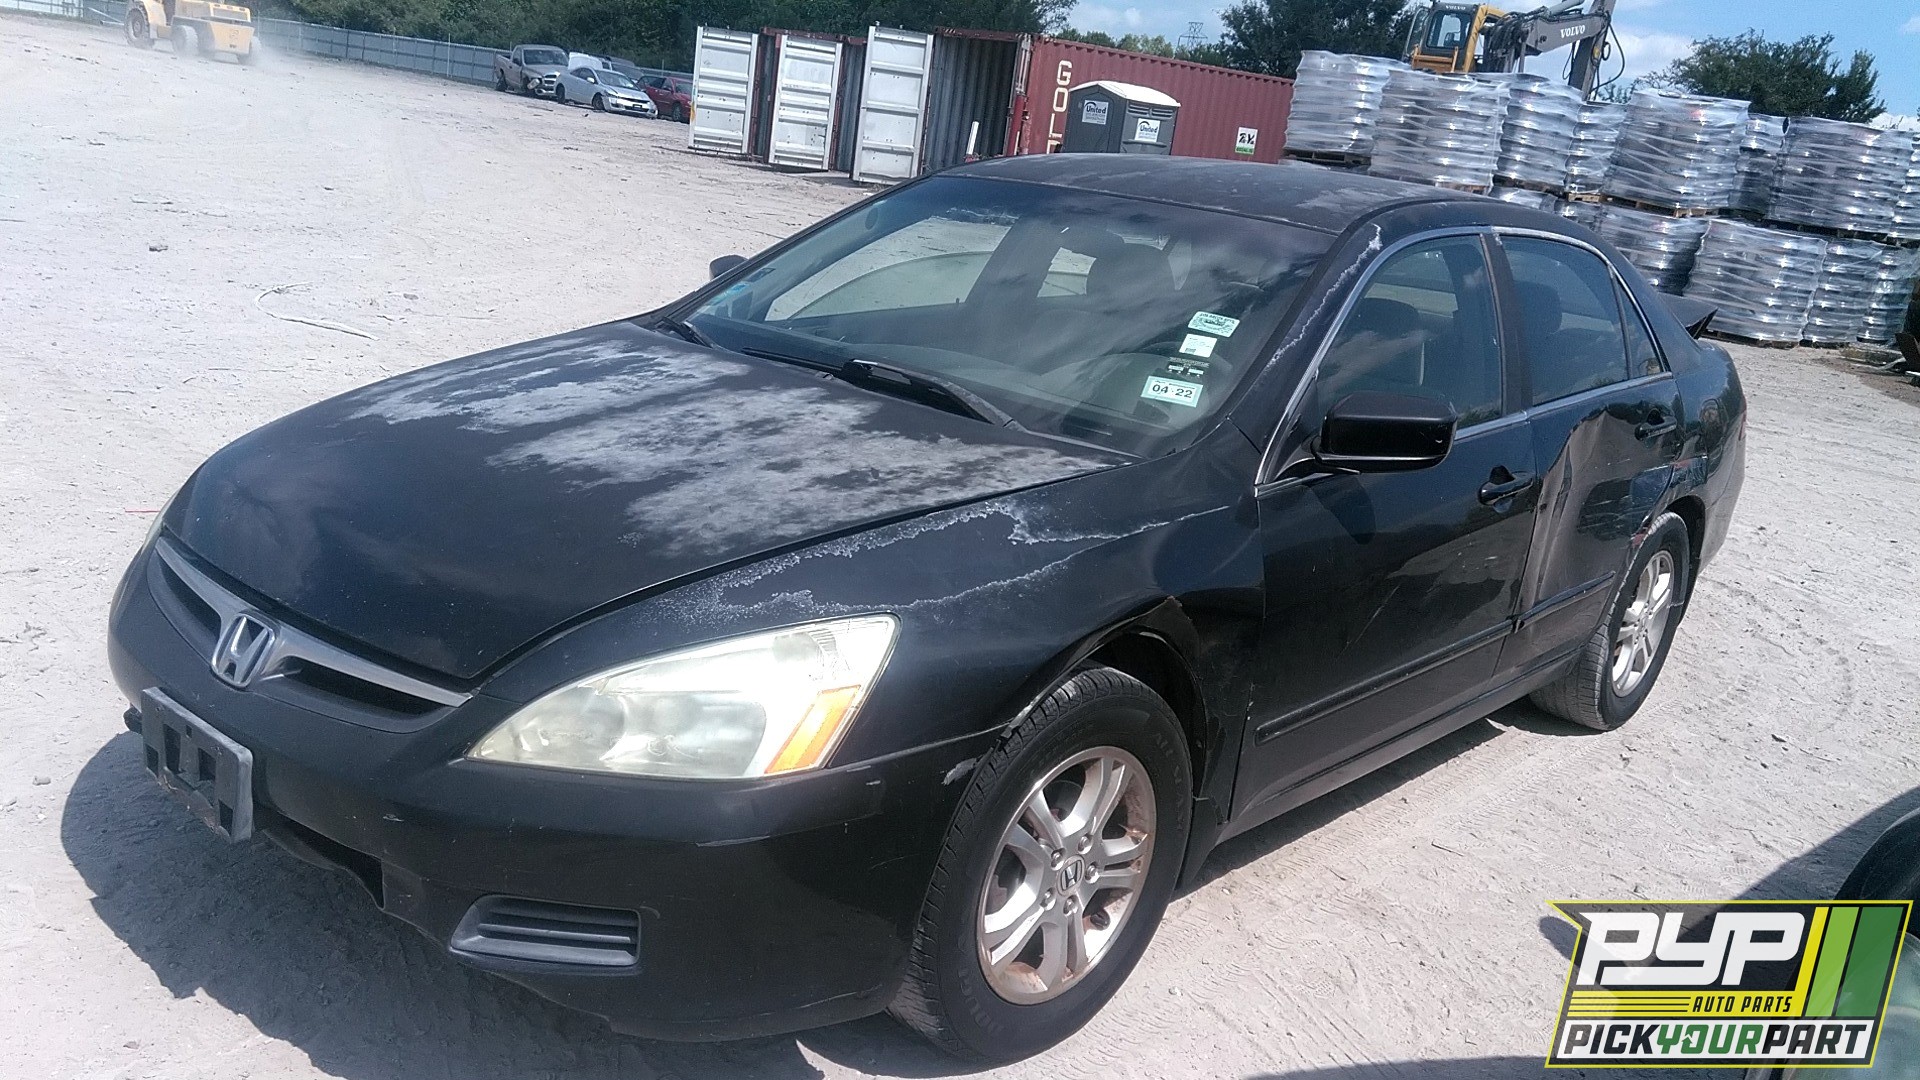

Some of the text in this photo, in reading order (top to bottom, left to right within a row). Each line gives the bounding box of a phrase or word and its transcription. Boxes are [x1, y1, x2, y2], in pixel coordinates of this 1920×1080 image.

[1560, 25, 1585, 38] VOLVO
[1086, 105, 1107, 114] United
[1140, 125, 1158, 133] United
